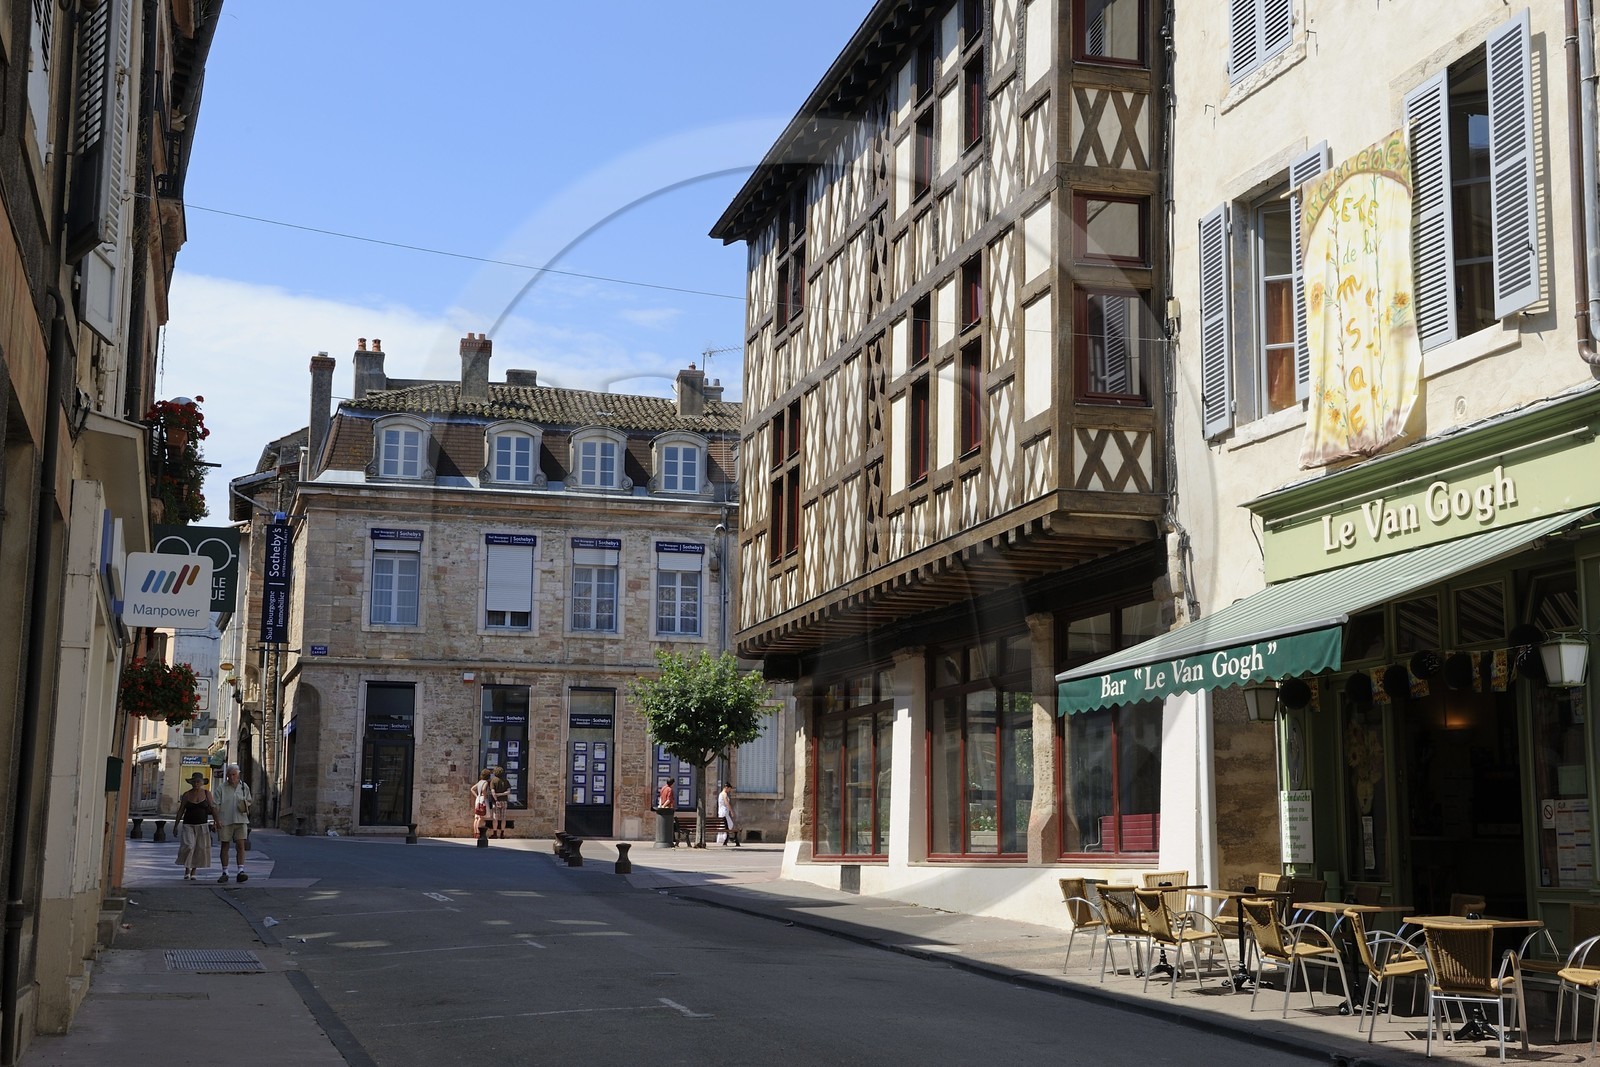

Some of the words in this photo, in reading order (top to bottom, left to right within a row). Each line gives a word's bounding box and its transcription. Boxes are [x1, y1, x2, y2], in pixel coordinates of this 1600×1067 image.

[1343, 239, 1357, 265] de
[1321, 514, 1356, 551] Le
[1361, 498, 1420, 539] Van
[1425, 466, 1517, 522] Gogh
[269, 527, 284, 577] Sotheby's
[132, 603, 200, 618] Manpower
[266, 590, 276, 626] Bourgogne
[276, 591, 285, 628] Immobilier
[1100, 674, 1127, 698] Bar
[1171, 659, 1204, 684] Van
